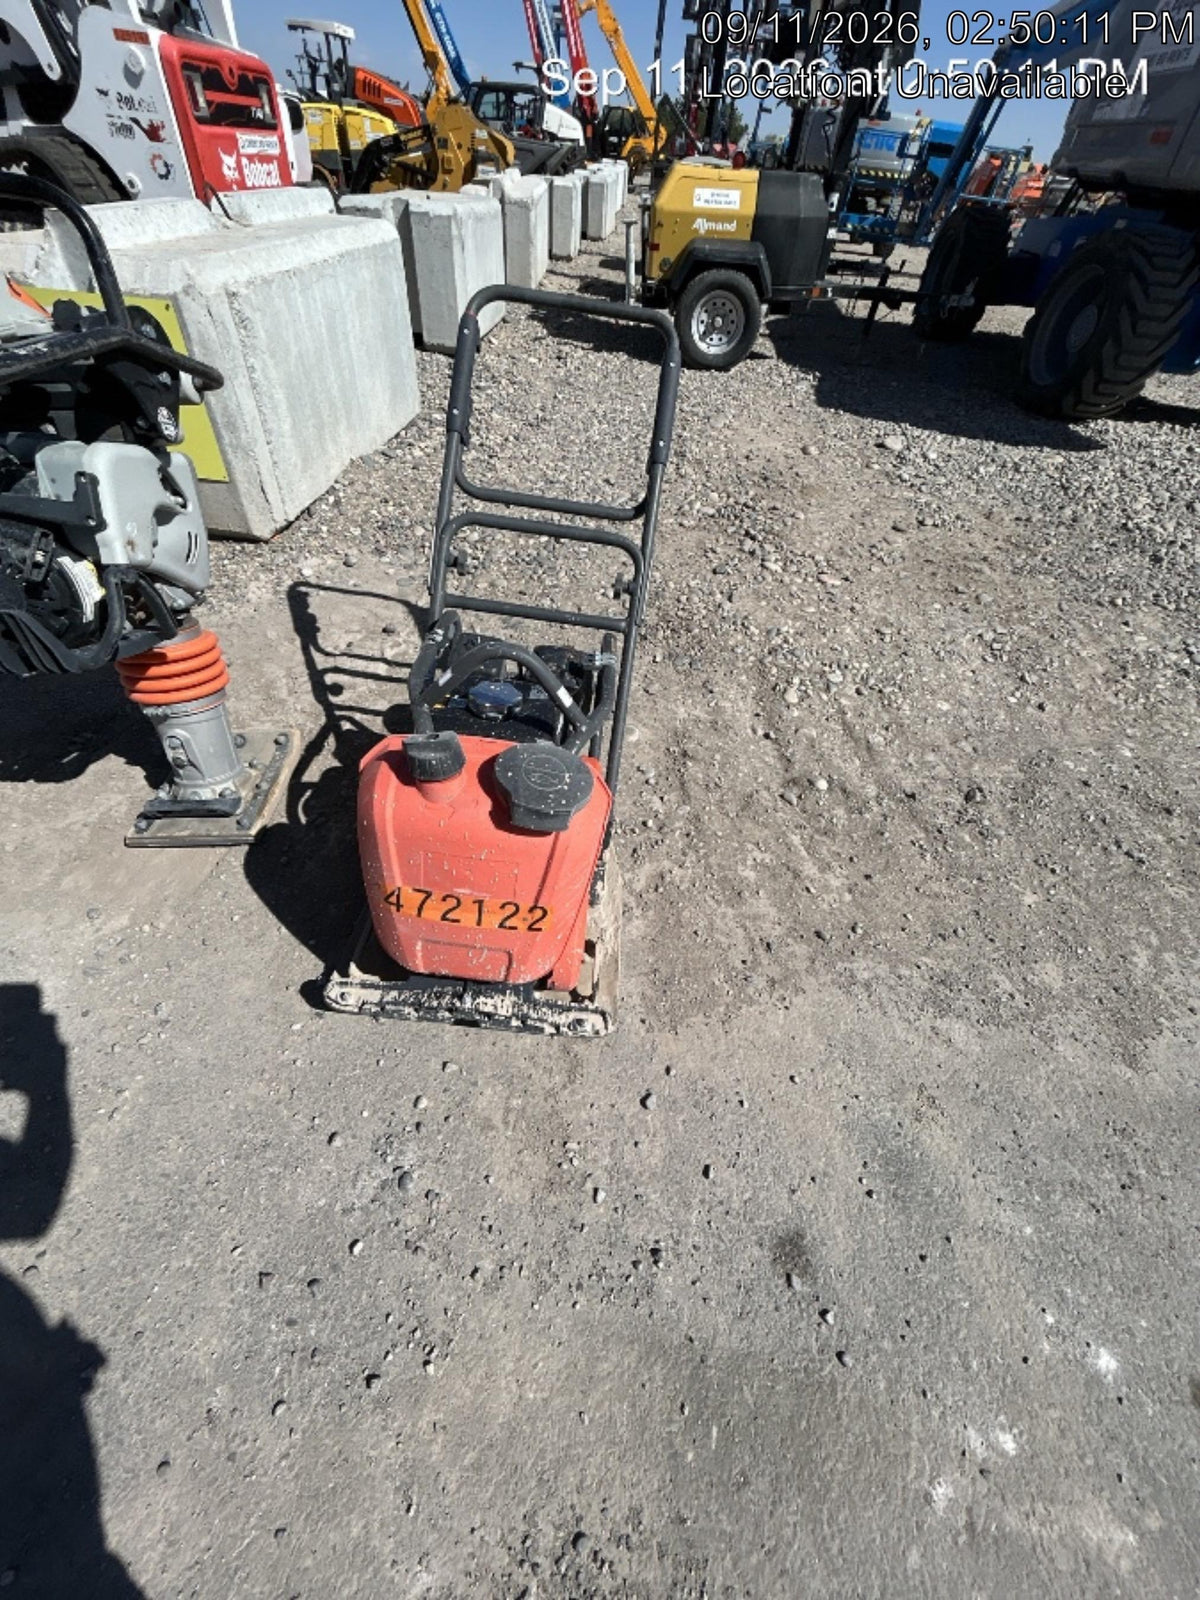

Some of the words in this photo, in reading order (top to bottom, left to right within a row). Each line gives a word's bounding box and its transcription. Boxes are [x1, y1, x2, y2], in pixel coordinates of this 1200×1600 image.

[241, 156, 281, 187] Bobcat
[691, 217, 737, 235] Allmand
[383, 886, 549, 932] 472122
